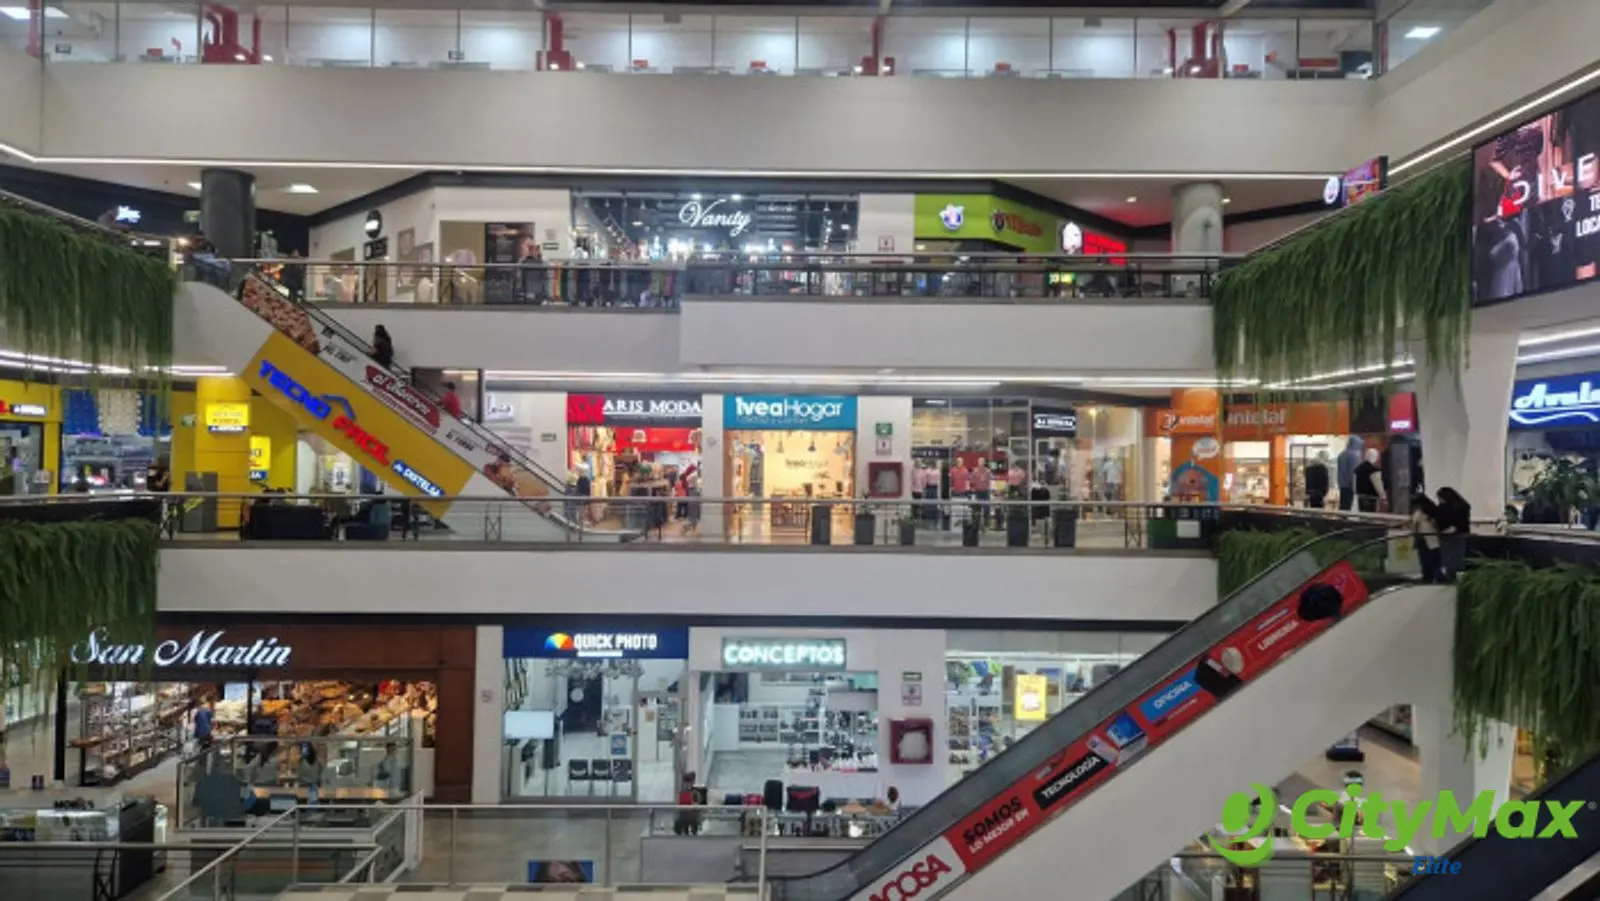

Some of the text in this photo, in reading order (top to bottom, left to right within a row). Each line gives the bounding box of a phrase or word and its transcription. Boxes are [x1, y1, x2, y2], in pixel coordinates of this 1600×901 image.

[679, 198, 750, 237] Vanity
[259, 359, 332, 420] TECNO
[649, 399, 703, 413] MODA
[71, 626, 145, 665] San
[574, 632, 657, 649] QUICK PHOTO
[724, 643, 845, 665] CONCEPTOS
[962, 795, 1021, 845] SOMOS
[969, 839, 984, 855] LO
